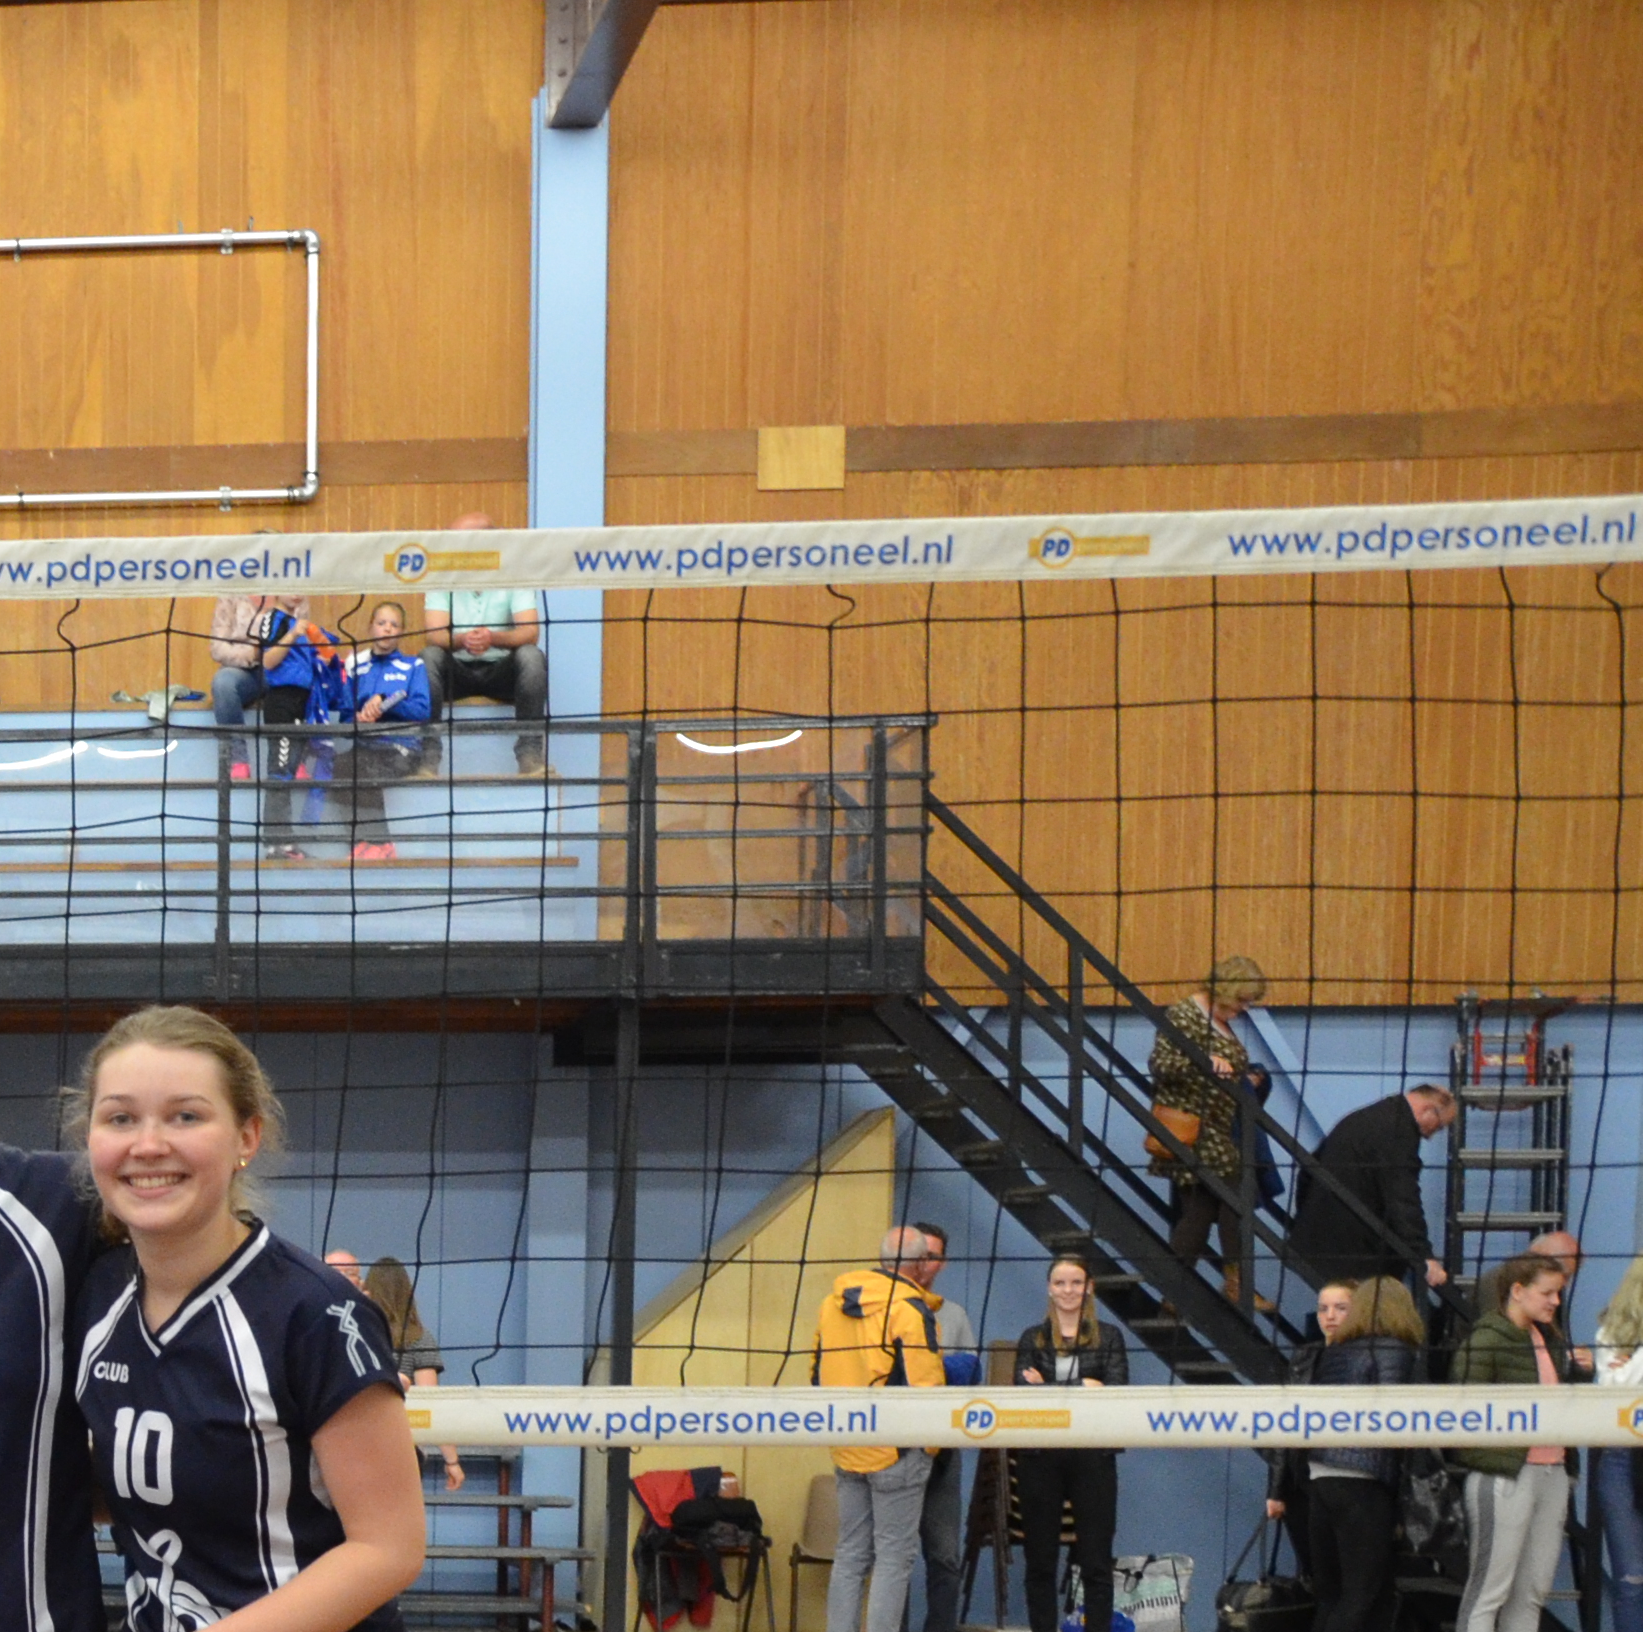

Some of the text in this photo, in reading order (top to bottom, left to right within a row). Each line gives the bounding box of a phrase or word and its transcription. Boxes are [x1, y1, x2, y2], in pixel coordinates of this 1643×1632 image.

[1041, 536, 1072, 557] PD
[1228, 512, 1637, 559] www.pdpersoneel.nl
[398, 553, 425, 573] PD
[574, 535, 954, 577] www.pdpersoneel.nl
[93, 1360, 129, 1384] CLUB
[504, 1404, 877, 1439] www.pdpersoneel.nl
[964, 1410, 993, 1428] PD
[1147, 1403, 1539, 1438] www.pdpersoneel.nl
[113, 1406, 174, 1506] 10
